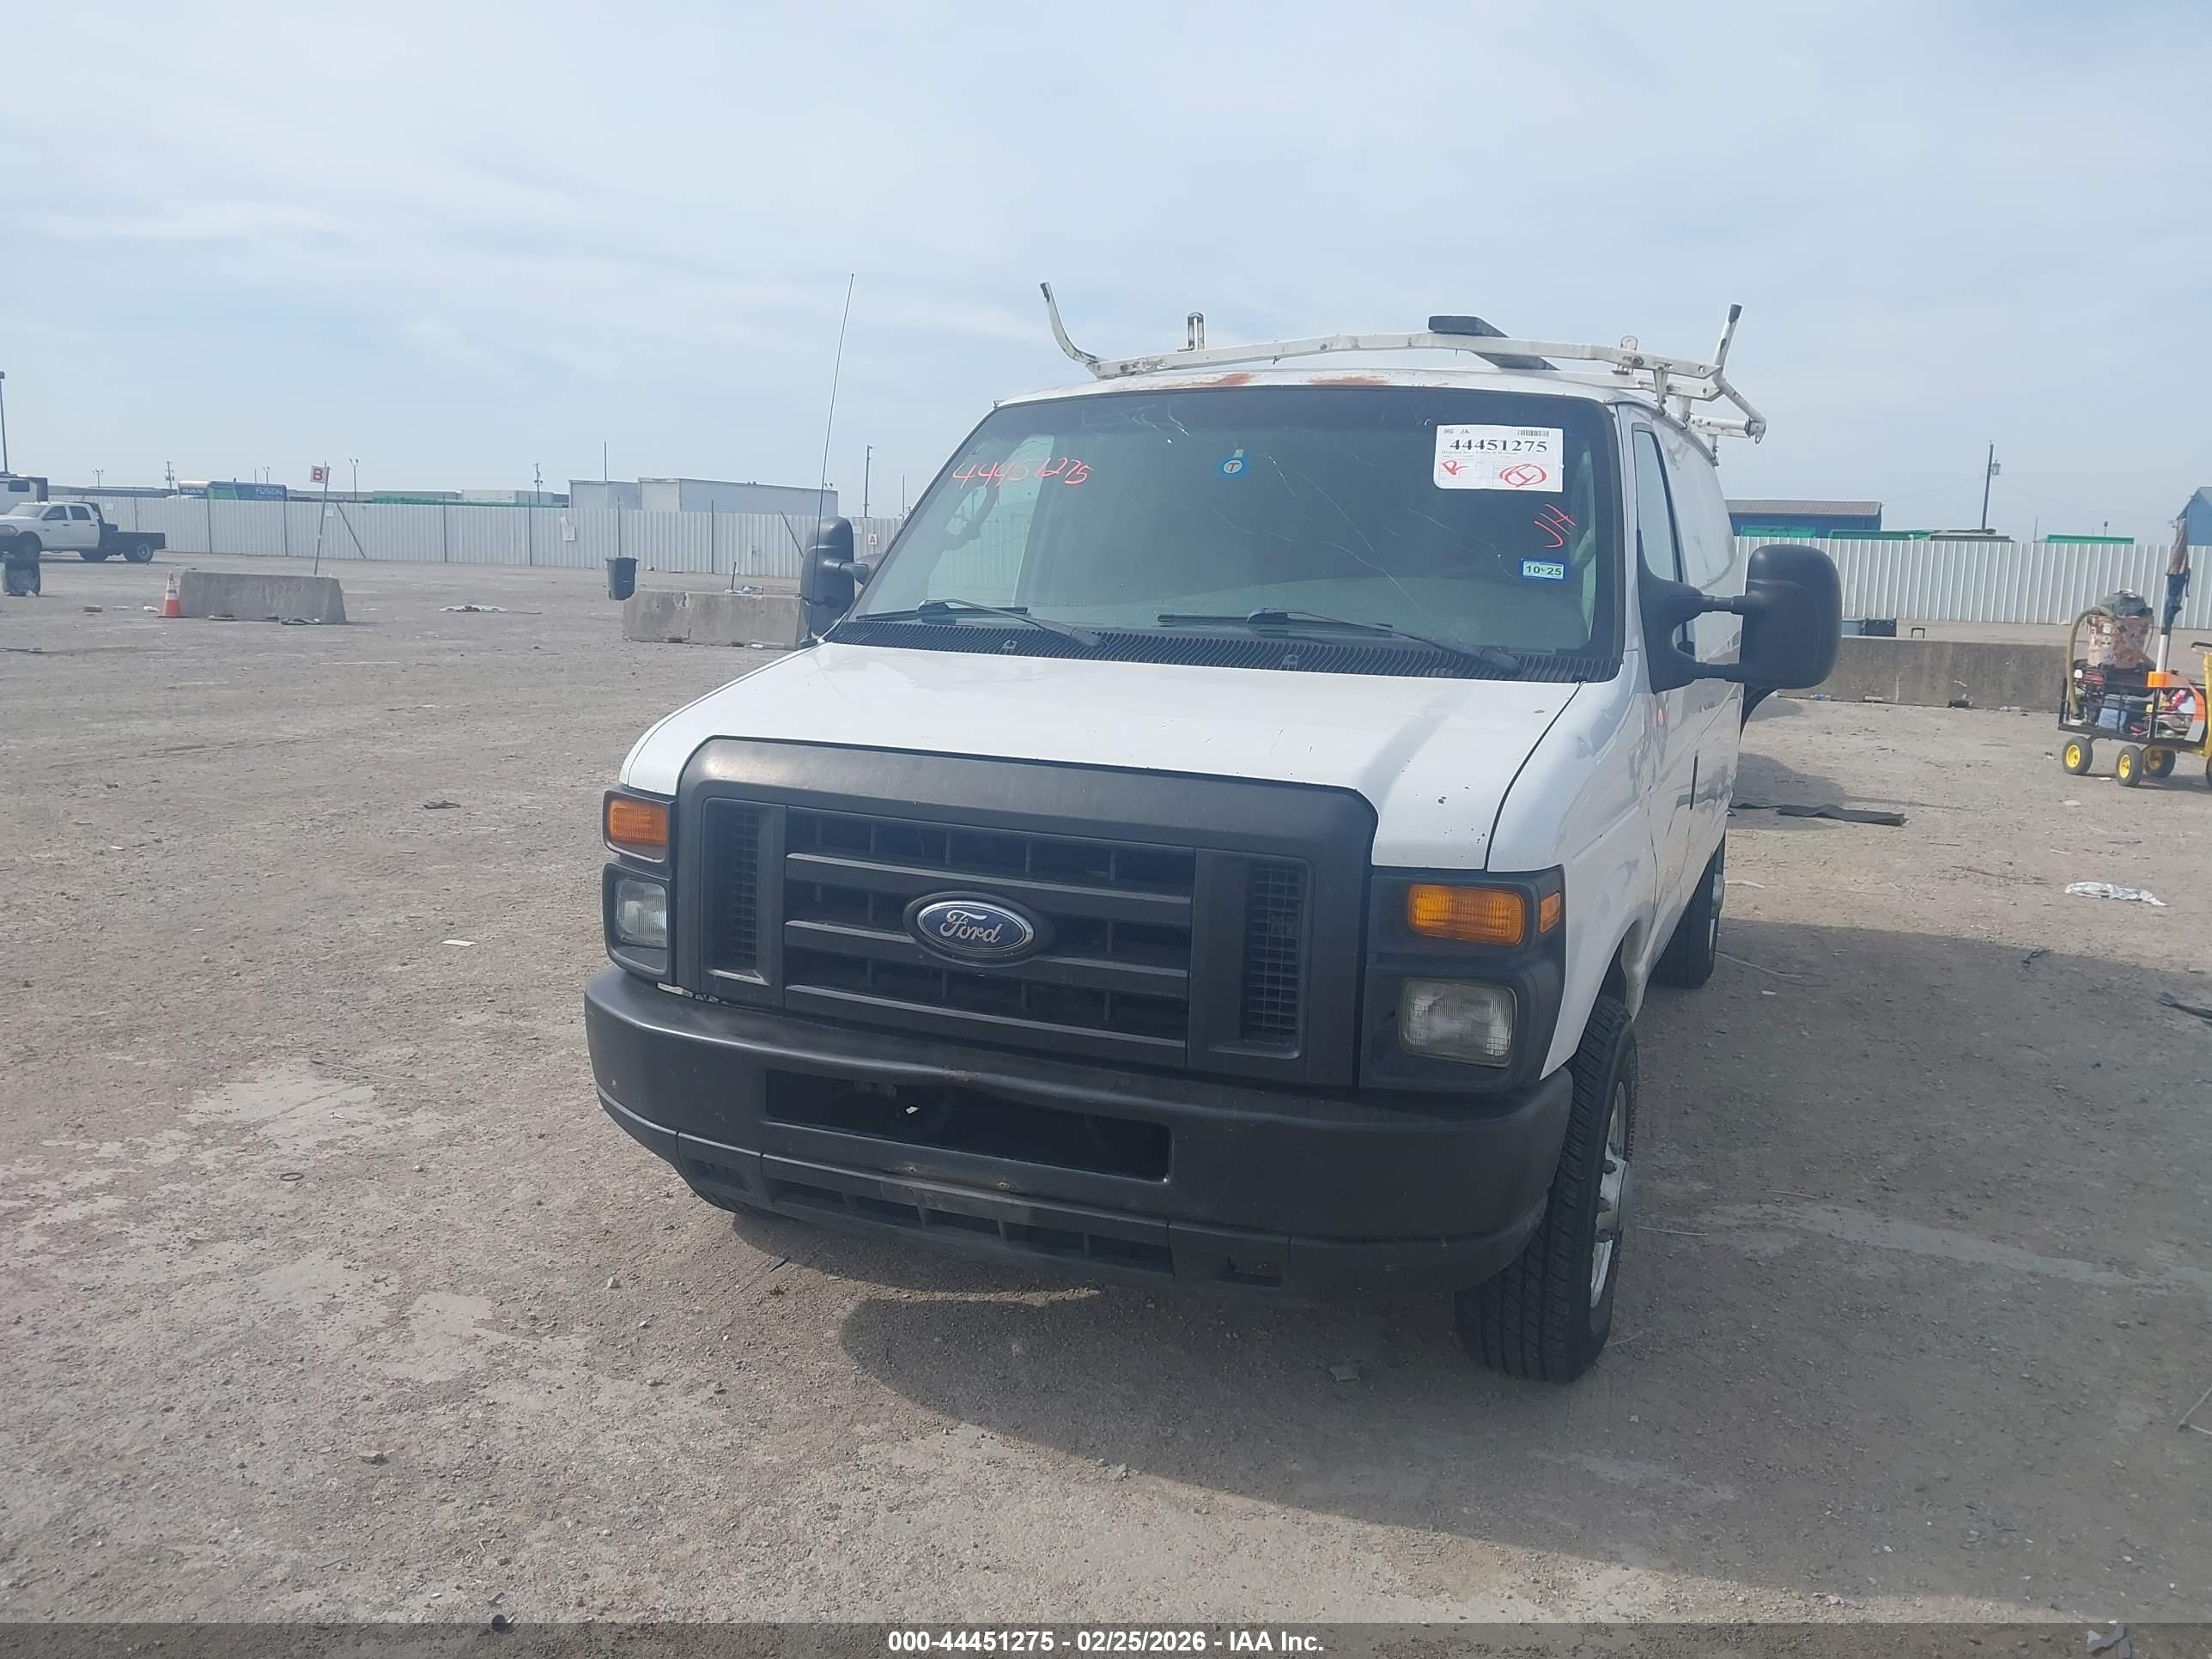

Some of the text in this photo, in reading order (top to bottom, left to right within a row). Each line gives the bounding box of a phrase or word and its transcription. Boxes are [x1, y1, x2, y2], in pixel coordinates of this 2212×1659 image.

[1449, 440, 1547, 453] 44451275
[1228, 462, 1240, 472] T
[313, 468, 323, 481] B
[869, 535, 877, 544] A
[1526, 565, 1562, 576] 10 25
[939, 909, 1004, 943] Ford
